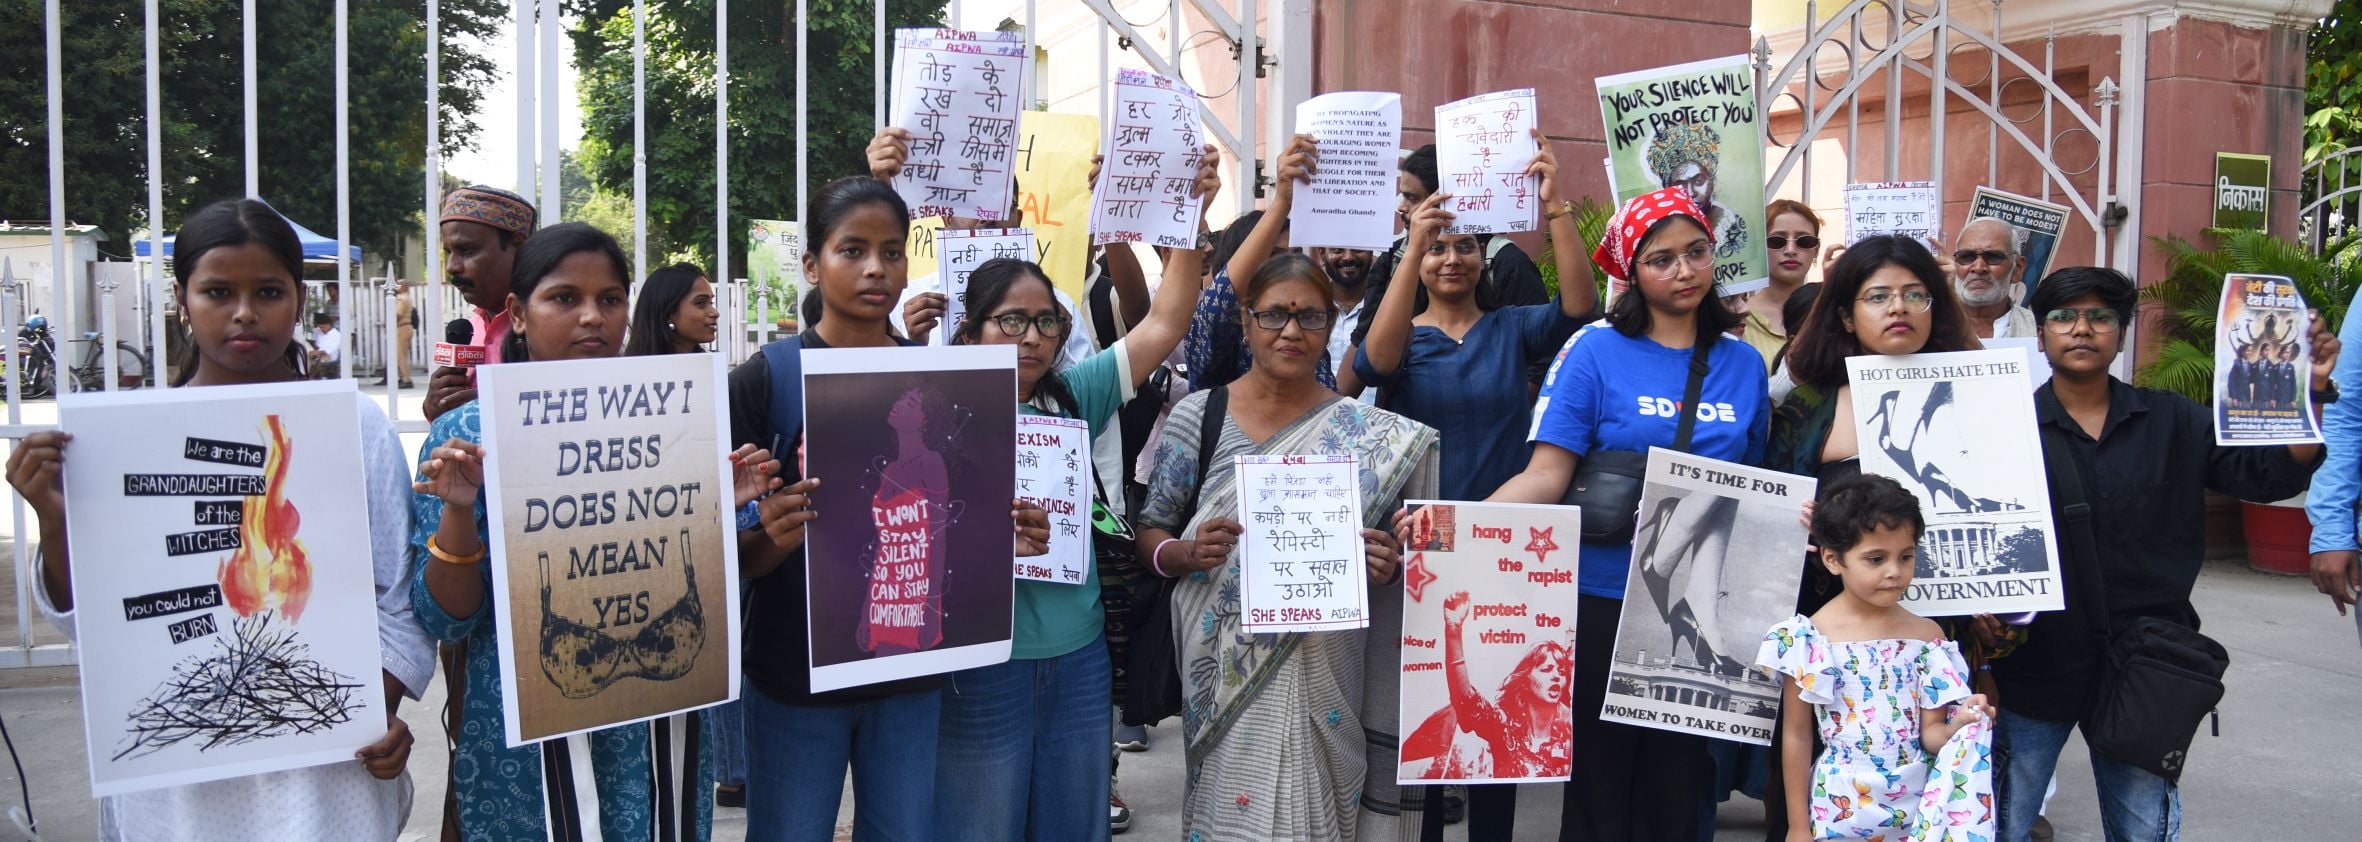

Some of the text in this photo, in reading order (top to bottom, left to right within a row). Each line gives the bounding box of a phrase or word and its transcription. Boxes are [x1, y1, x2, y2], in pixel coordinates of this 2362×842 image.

[935, 30, 977, 41] AIPWA
[946, 43, 981, 54] AIPWA
[919, 53, 1005, 86] तोड़ के
[915, 86, 1007, 112] रख दो
[1649, 75, 1710, 107] SILENCE
[1711, 72, 1750, 96] WILL
[915, 109, 949, 131] वो
[1124, 100, 1155, 119] हर
[1493, 102, 1526, 122] की
[1173, 123, 1199, 146] के
[1614, 118, 1645, 150] NOT
[1649, 105, 1719, 137] PROTECT
[1340, 149, 1378, 157] BECOMING
[1470, 147, 1502, 168] है
[958, 162, 1002, 185] है
[1451, 166, 1527, 187] सारी रात
[925, 186, 976, 203] आज
[1455, 187, 1534, 211] हमारी है
[2219, 176, 2265, 212] निकास
[919, 206, 954, 218] SPEAKS
[1105, 196, 1197, 223] नारा है
[1856, 207, 1926, 226] महिला सुरक्षा
[1978, 207, 2000, 217] HAVE
[2025, 219, 2058, 231] MODEST
[1988, 200, 2020, 213] WOMAN
[2022, 208, 2043, 219] DOES
[2044, 213, 2061, 223] NOT
[1100, 230, 1187, 247] SHE SPEAKS AIPWA
[1445, 225, 1492, 234] SHE SPEAKS
[950, 244, 982, 264] नहीं
[1860, 362, 2019, 380] HOT GIRLS HATE THE
[519, 380, 693, 426] THE WAY I
[187, 440, 261, 462] We are the
[1017, 433, 1061, 448] EXISM
[557, 434, 661, 476] DRESS
[1060, 454, 1081, 472] के
[128, 475, 266, 493] GRANDDAUGHTERS
[1670, 462, 1787, 496] IT'S TIME FOR
[197, 505, 240, 523] of the
[524, 482, 700, 533] DOES NOT
[872, 499, 929, 526] I WON'T
[1291, 511, 1312, 525] पर
[1323, 505, 1351, 522] नहीं
[880, 528, 927, 543] STAY
[1056, 518, 1080, 538] लिए
[1472, 524, 1512, 543] hang
[168, 529, 239, 552] WITCHES
[567, 536, 668, 579] MEAN
[879, 543, 929, 565] SILENT
[874, 562, 924, 581] SO YOU
[1027, 565, 1052, 579] SPEAKS
[1269, 559, 1349, 576] पर सवाल
[1498, 558, 1572, 587] the rapist
[871, 578, 929, 601] CAN STAY
[1274, 575, 1333, 600] उठाओ
[1897, 578, 2050, 601] OVERNMENT
[127, 588, 216, 620] you could not
[593, 591, 650, 629] YES
[869, 602, 925, 628] COMFORTABLE
[1251, 607, 1360, 623] SHE SPEAKS AIPWA
[1473, 603, 1561, 627] protect the
[171, 616, 216, 640] BURN
[1479, 629, 1525, 643] victim
[1425, 638, 1436, 648] of
[1403, 662, 1442, 672] women
[1605, 704, 1771, 739] WOMEN TO TAKE OVER
